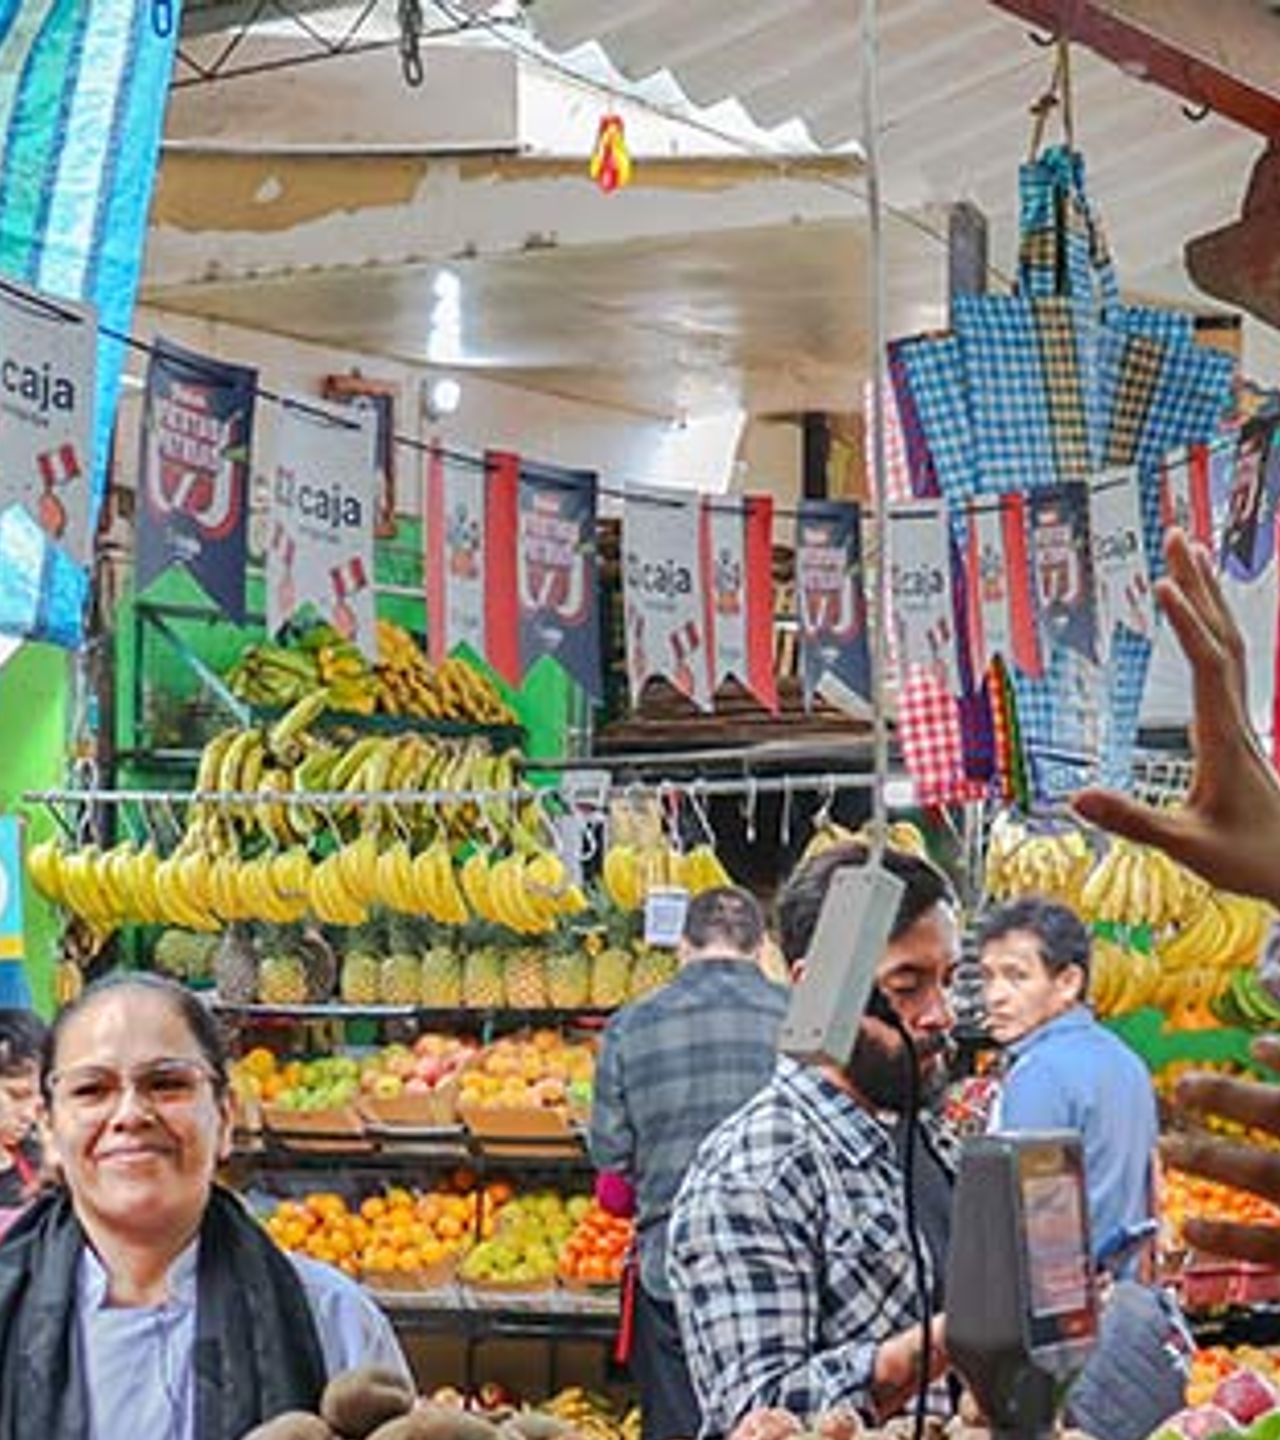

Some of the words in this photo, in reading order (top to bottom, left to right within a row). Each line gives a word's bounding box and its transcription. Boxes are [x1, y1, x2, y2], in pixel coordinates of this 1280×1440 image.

[1, 357, 76, 412] caja
[298, 483, 362, 528] caja
[642, 559, 693, 598] caja
